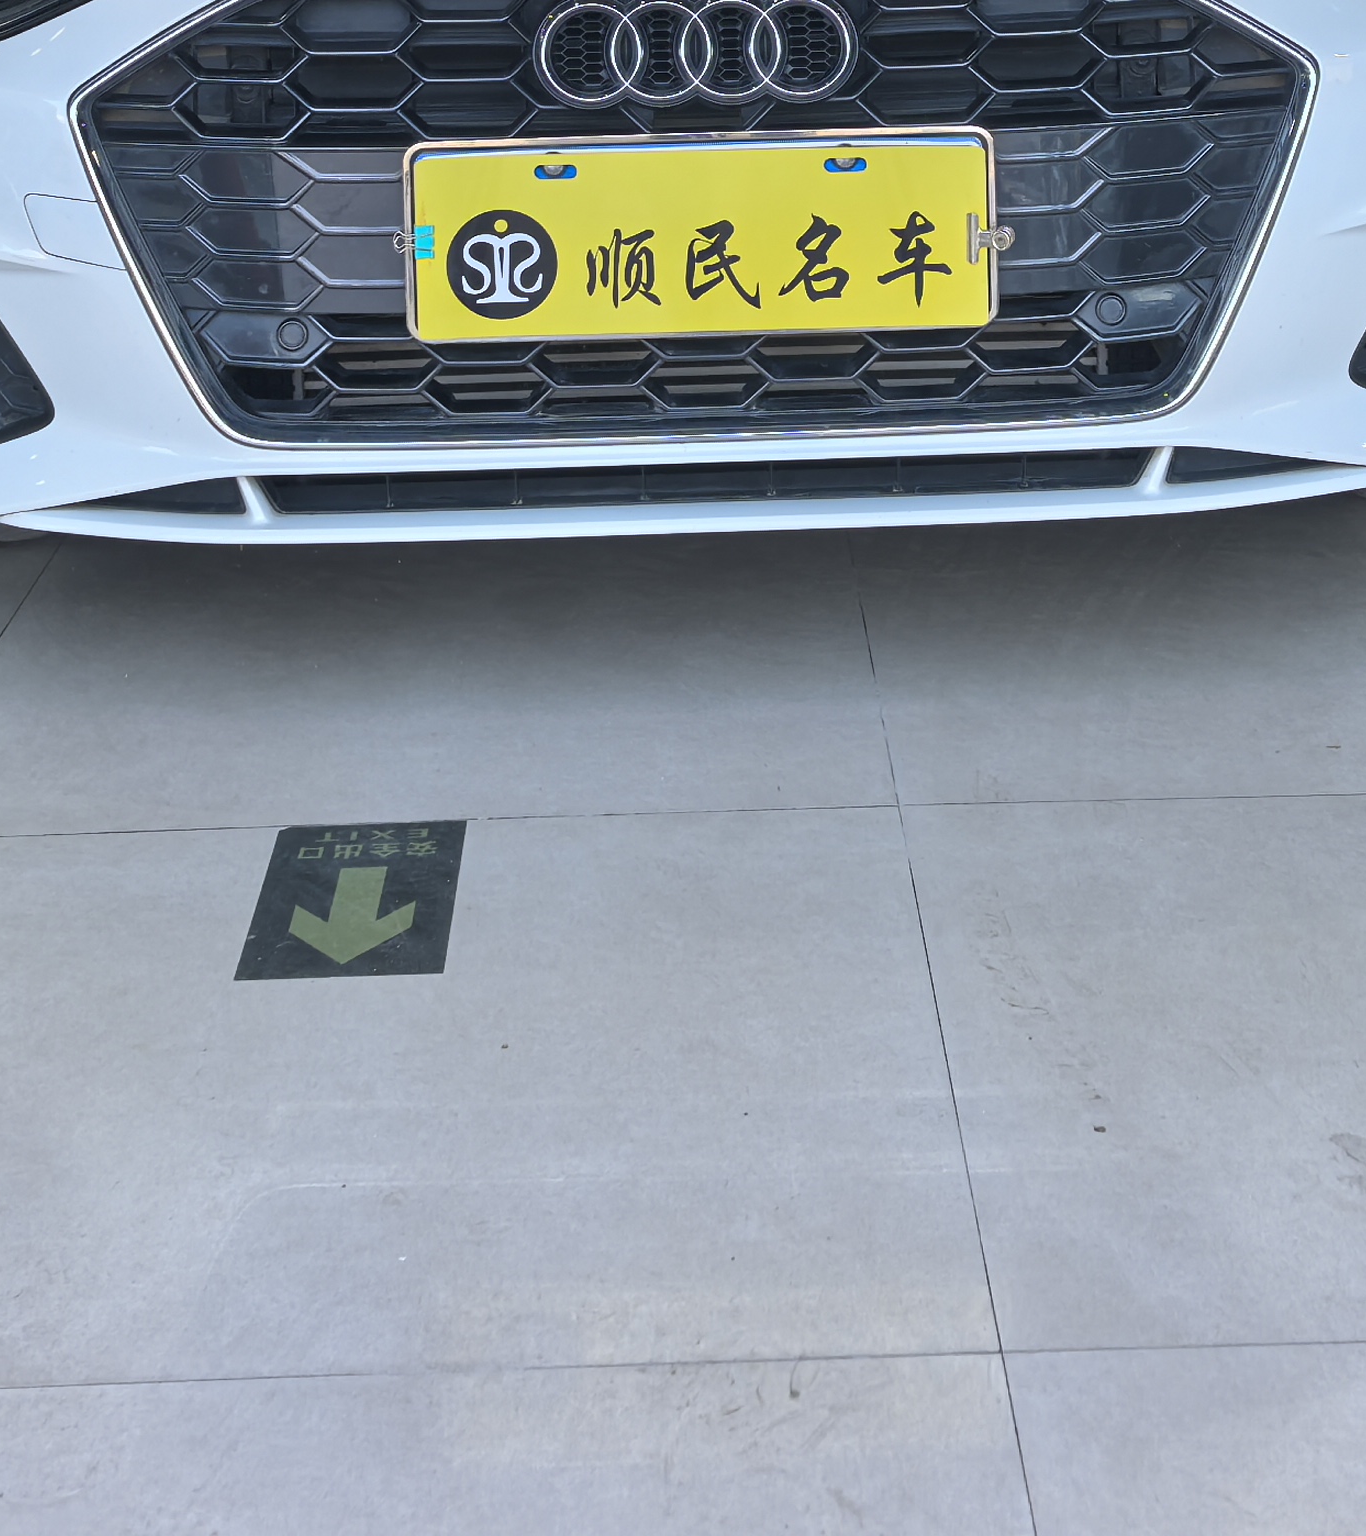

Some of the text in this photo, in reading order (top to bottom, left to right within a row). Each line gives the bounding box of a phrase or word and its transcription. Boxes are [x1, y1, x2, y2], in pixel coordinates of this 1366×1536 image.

[586, 211, 952, 309] 顺民名车
[315, 827, 430, 843] EXIT
[297, 840, 438, 860] 安全出口
